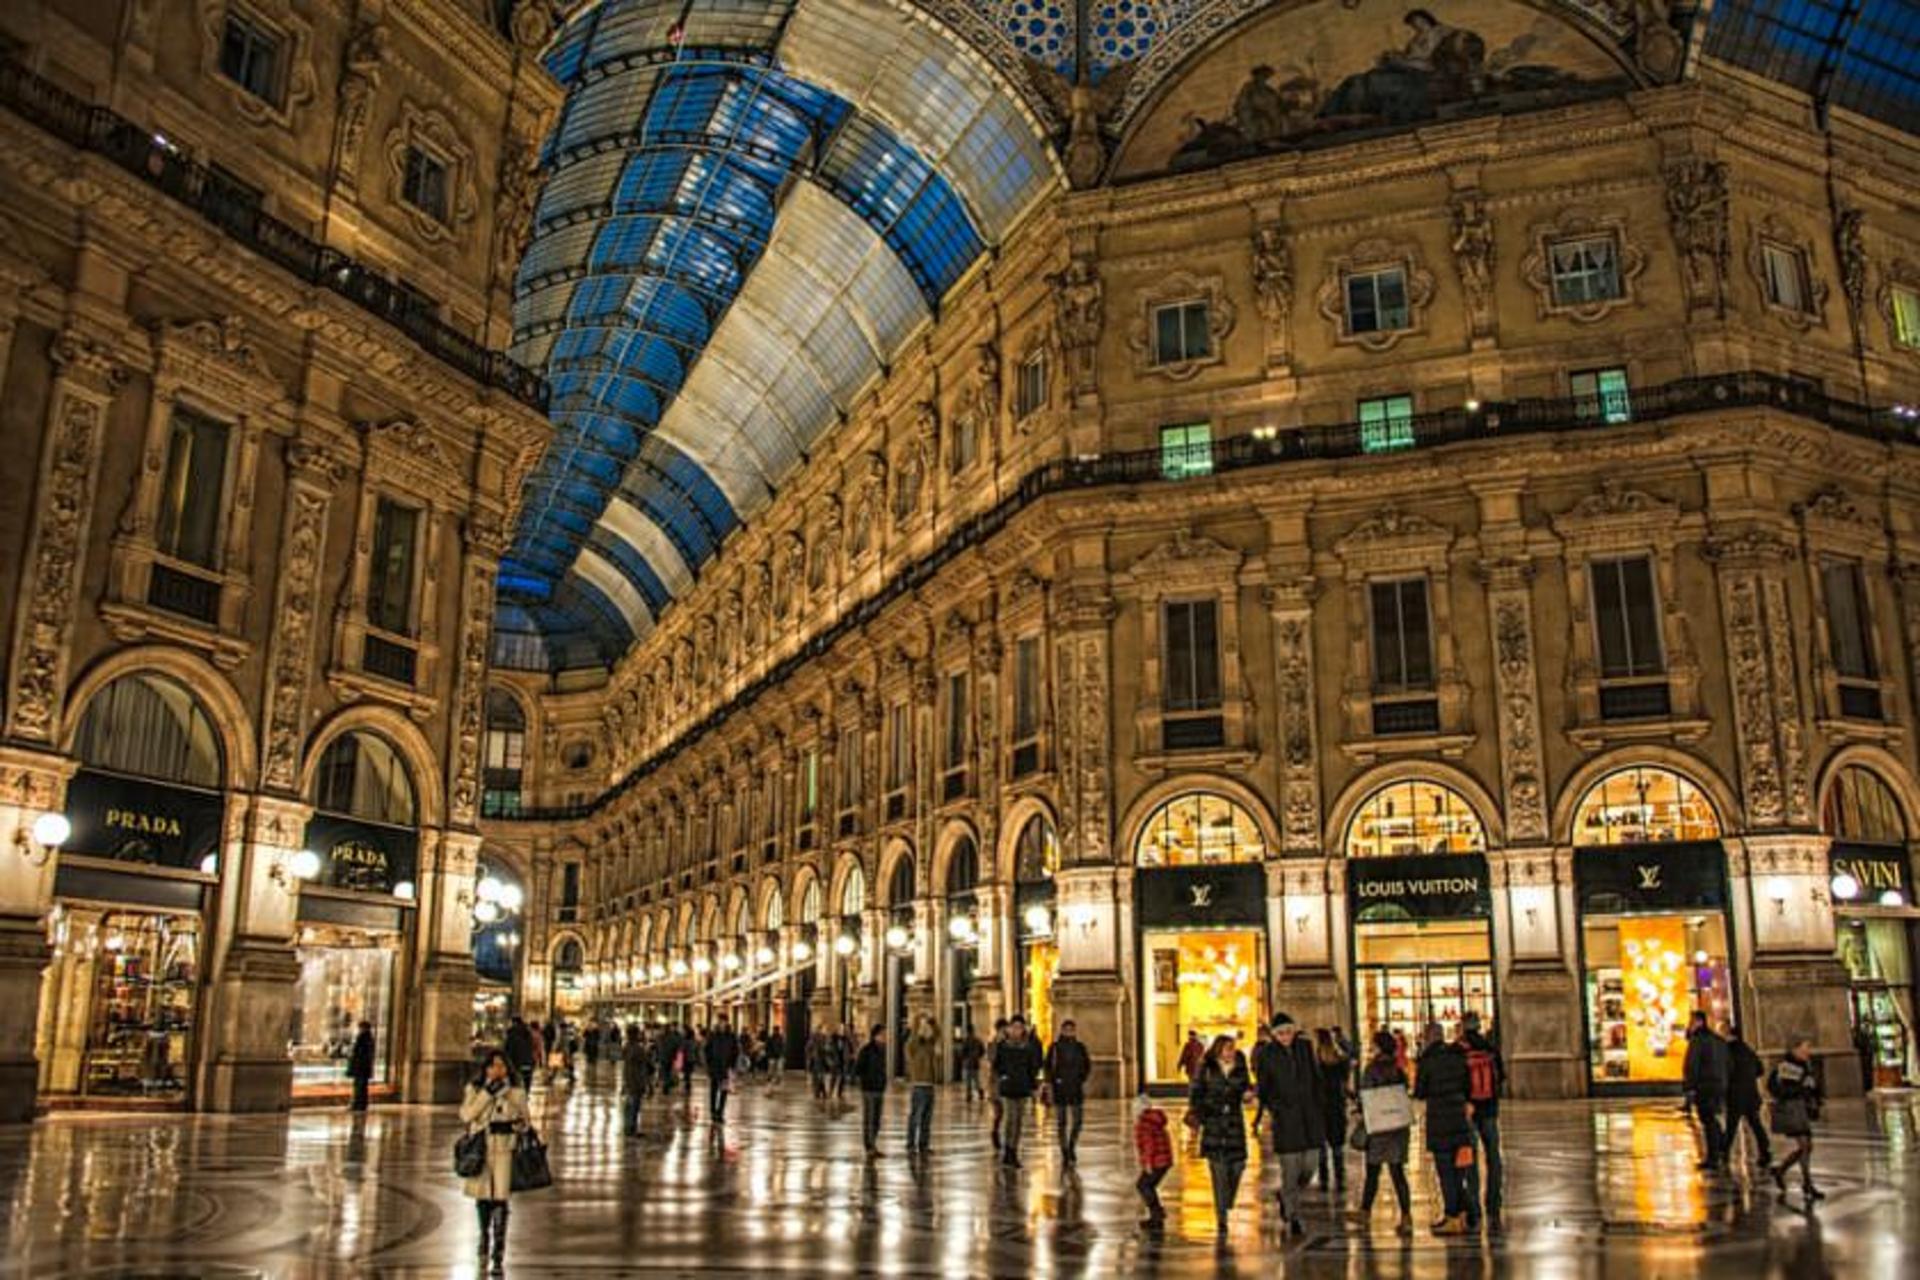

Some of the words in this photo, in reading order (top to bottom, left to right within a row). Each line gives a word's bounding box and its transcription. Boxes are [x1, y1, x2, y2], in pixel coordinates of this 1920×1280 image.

[105, 809, 181, 836] PRADA
[331, 842, 388, 868] PRADA
[1358, 881, 1405, 897] LOUIS
[1407, 878, 1478, 895] VUITTON
